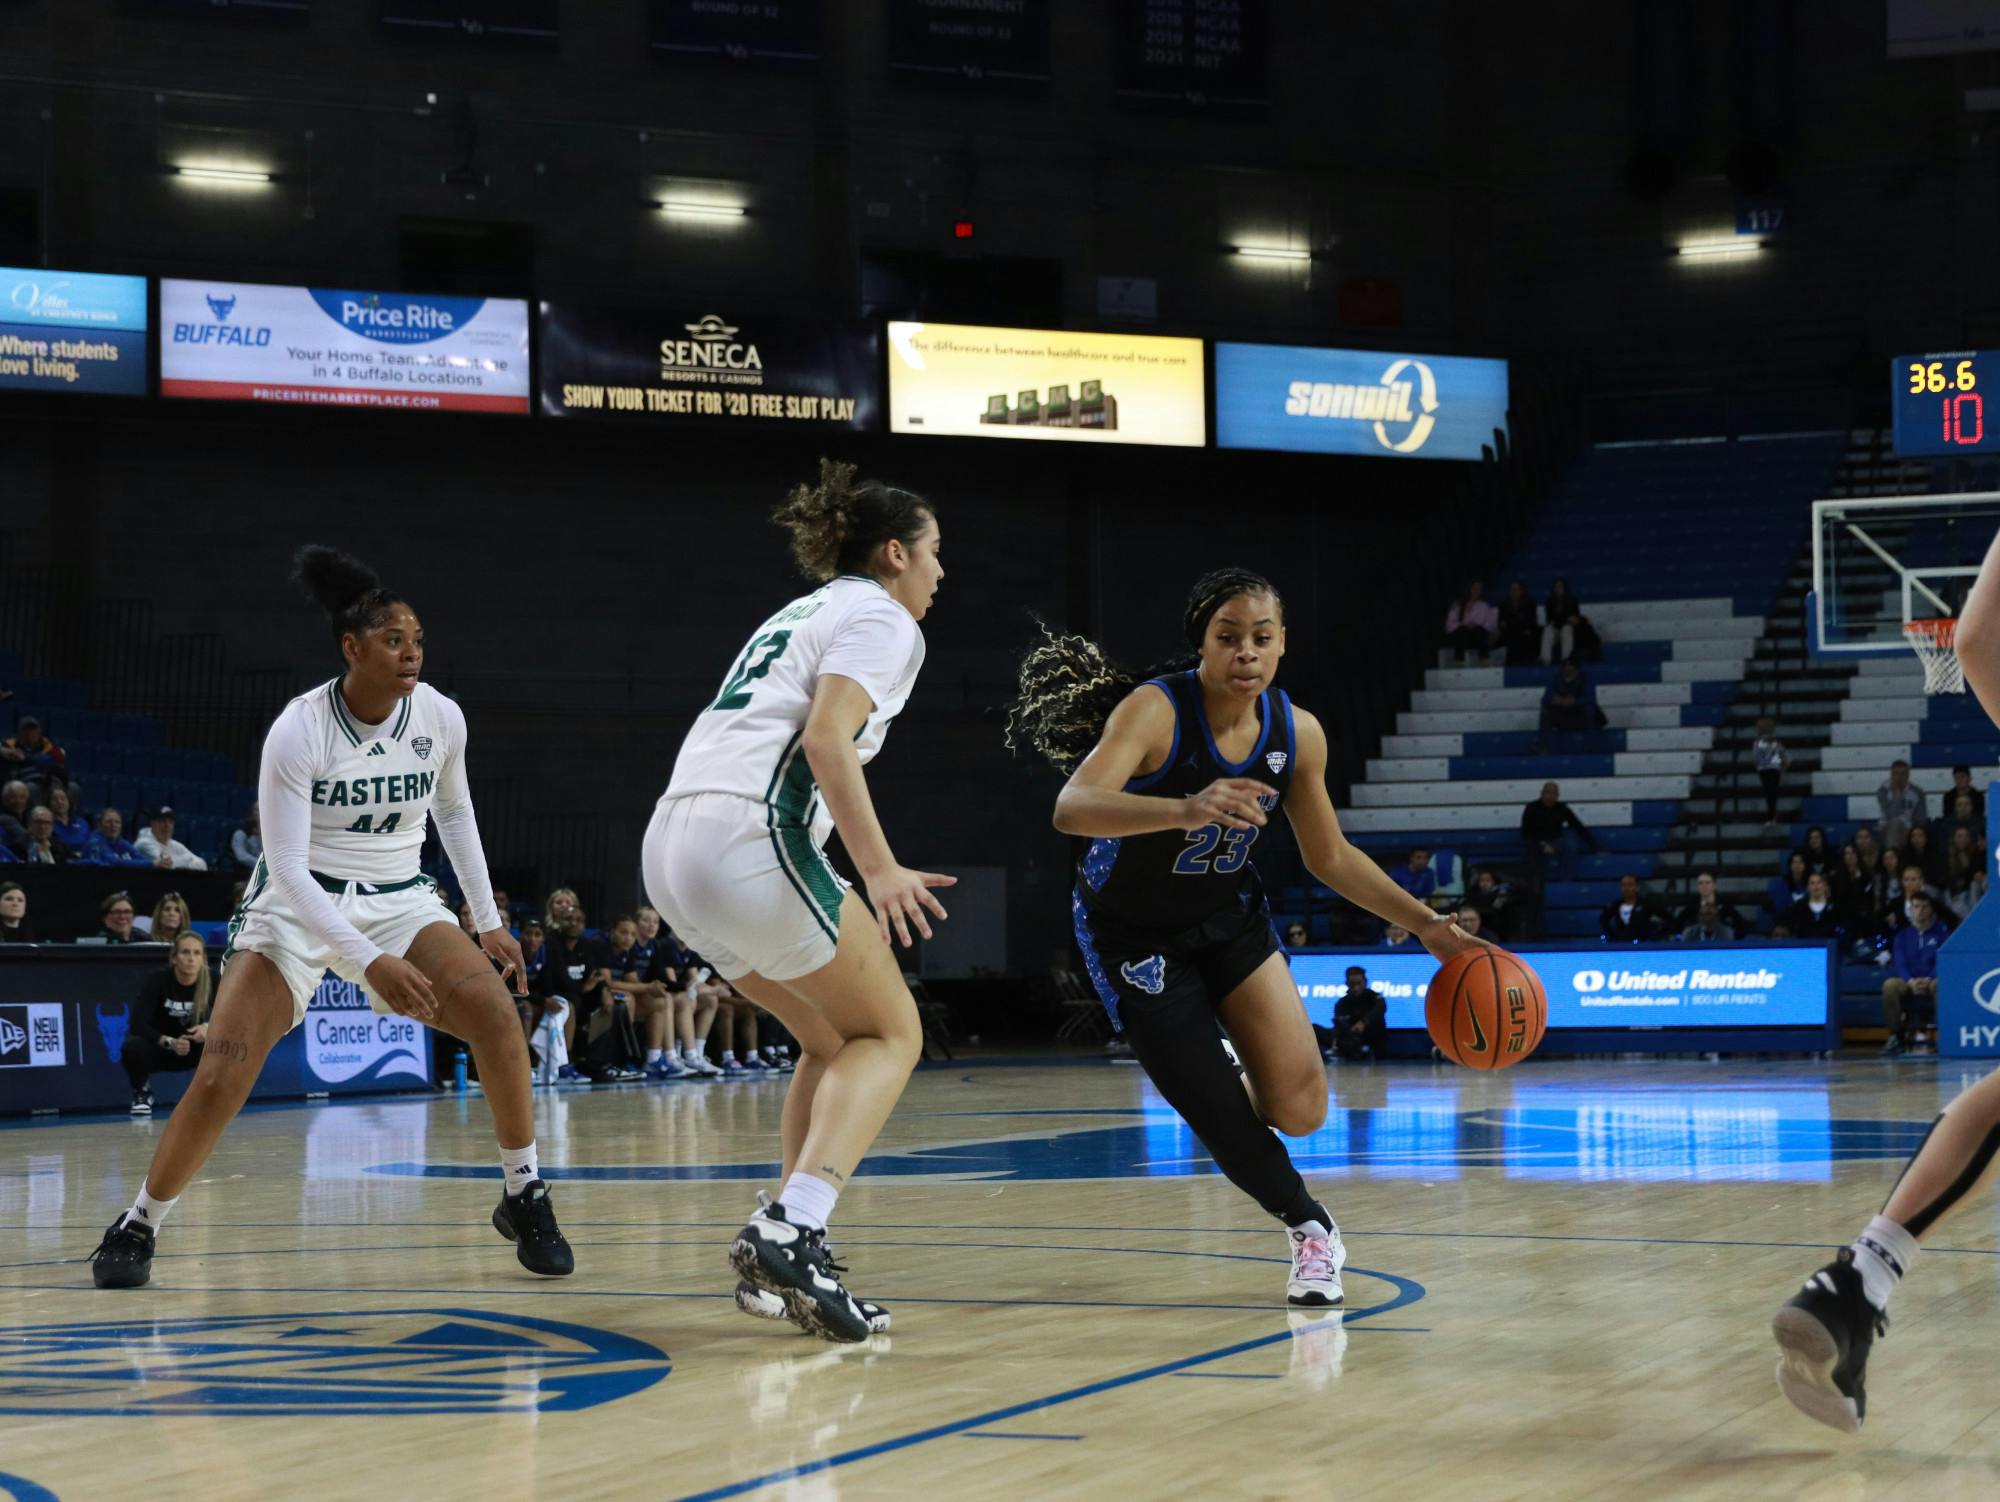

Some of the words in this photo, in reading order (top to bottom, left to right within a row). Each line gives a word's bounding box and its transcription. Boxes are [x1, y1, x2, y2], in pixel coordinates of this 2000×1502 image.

[1143, 48, 1184, 66] 2021
[1747, 208, 1784, 231] 117
[341, 298, 404, 328] Price
[406, 304, 453, 331] Rite
[173, 323, 272, 347] BUFFALO
[0, 335, 48, 357] Where
[51, 339, 119, 361] students
[287, 346, 322, 362] Your
[327, 349, 374, 364] Home
[660, 340, 763, 371] SENECA
[932, 340, 991, 353] difference
[994, 343, 1045, 356] between
[33, 358, 80, 383] living.
[313, 365, 328, 378] in
[332, 366, 342, 379] 4
[347, 367, 404, 382] Buffalo
[408, 370, 484, 387] Locations
[1909, 360, 1977, 394] 36.6
[252, 386, 441, 408] PRICERITEMARKETPLACE.COM
[563, 384, 604, 409] SHOW
[606, 386, 644, 411] YOUR
[646, 389, 694, 414] TICKET
[696, 392, 723, 415] FOR
[725, 393, 749, 416] $20
[751, 394, 784, 418] FREE
[786, 396, 820, 420] SLOT
[822, 398, 856, 421] PLAY
[1943, 392, 1983, 445] 10
[311, 770, 435, 807] EASTERN
[344, 811, 402, 834] 44
[1172, 822, 1260, 875] 23
[1606, 969, 1688, 991] United
[1689, 968, 1778, 990] Rentals
[34, 1017, 59, 1034] NEW
[316, 1017, 373, 1045] Cancer
[377, 1016, 414, 1043] Care
[1506, 986, 1527, 1054] ELITE
[35, 1034, 61, 1052] ERA
